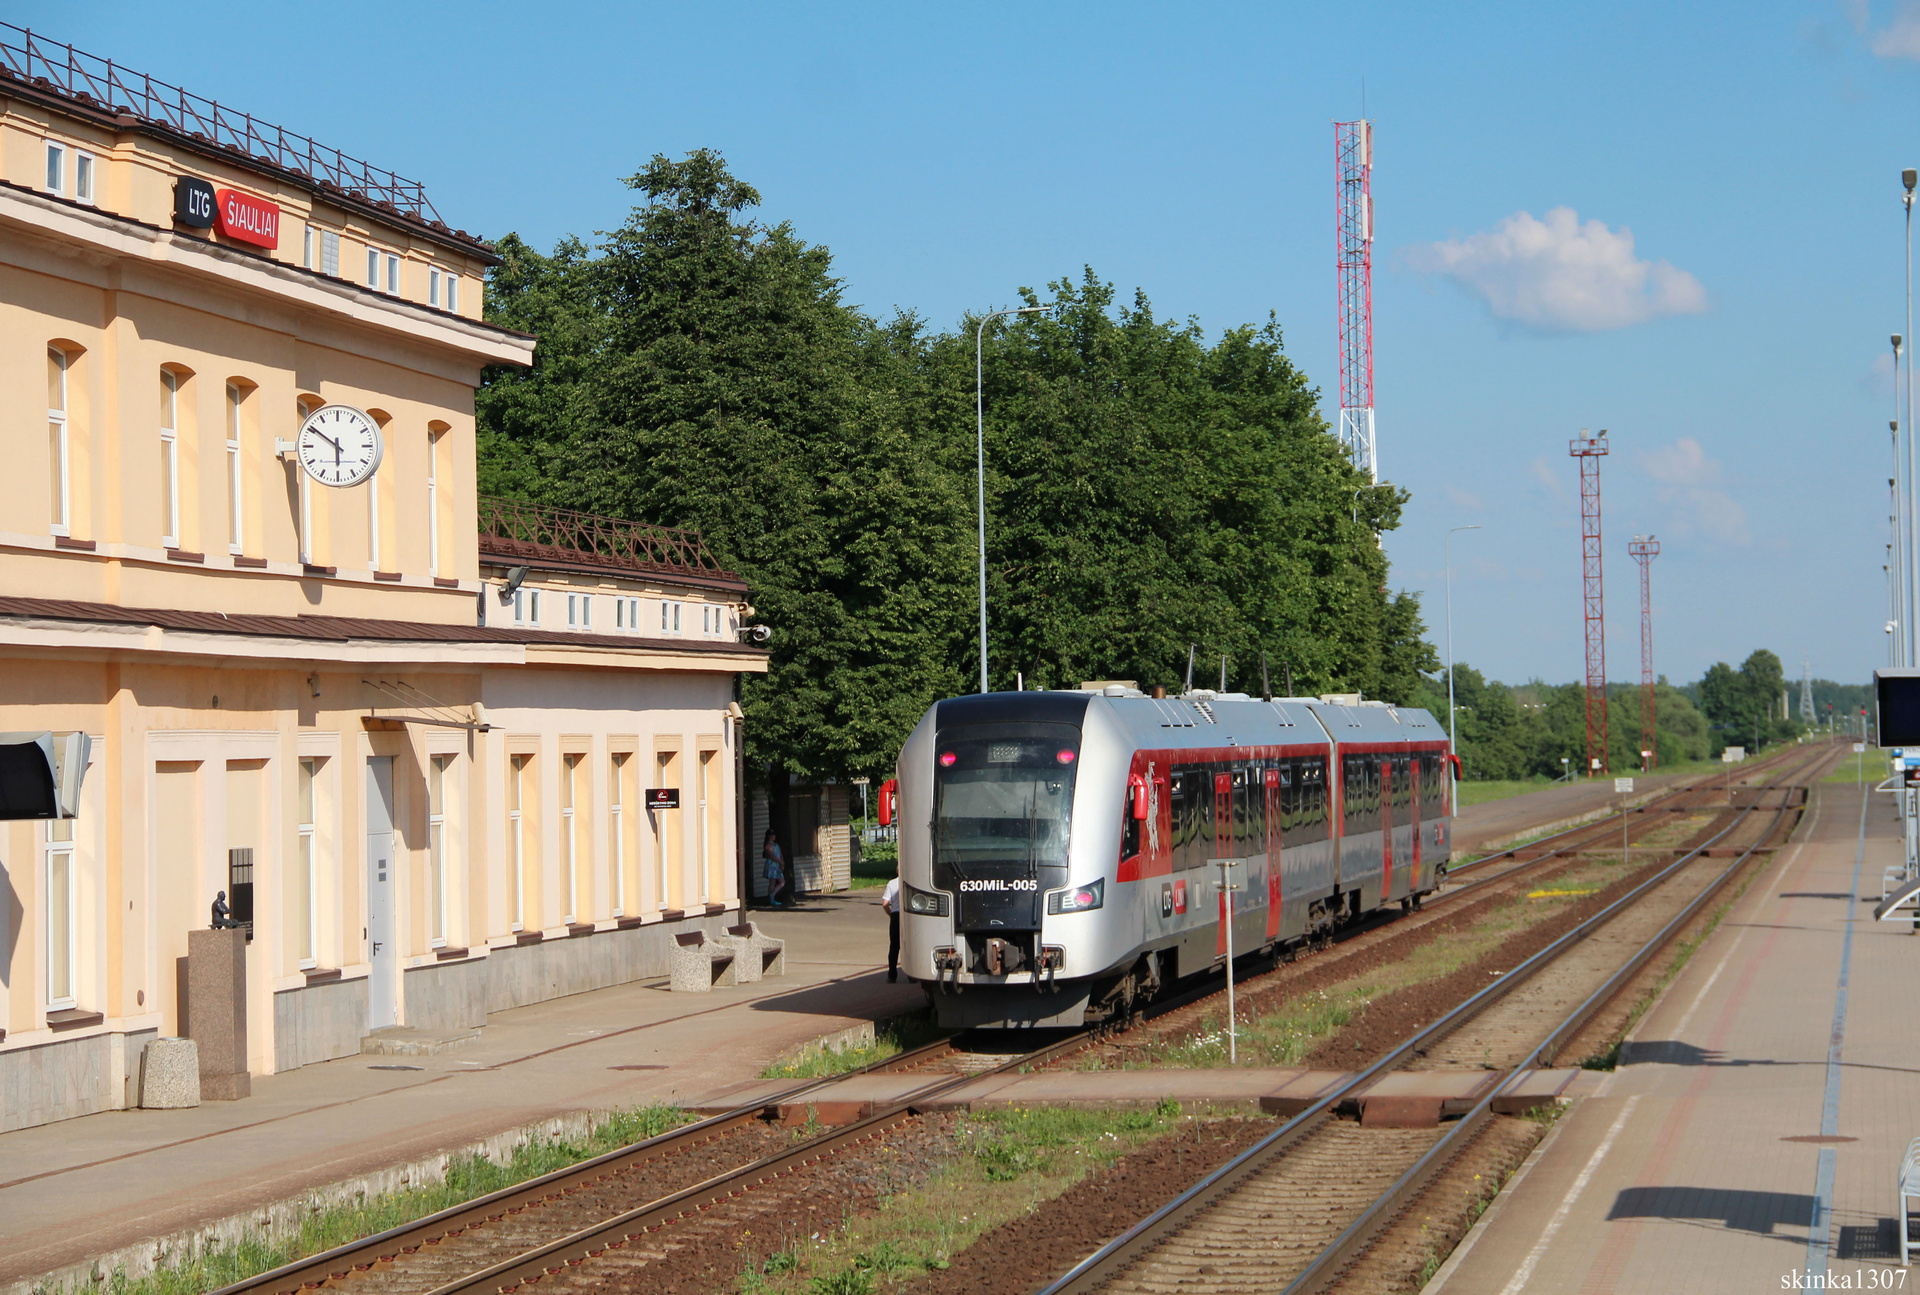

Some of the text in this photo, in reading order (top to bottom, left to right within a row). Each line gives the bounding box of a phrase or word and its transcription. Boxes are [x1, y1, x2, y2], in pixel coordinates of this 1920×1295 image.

[188, 188, 276, 239] LTG ŠIAULIAI
[960, 880, 1038, 892] 630MiL-005
